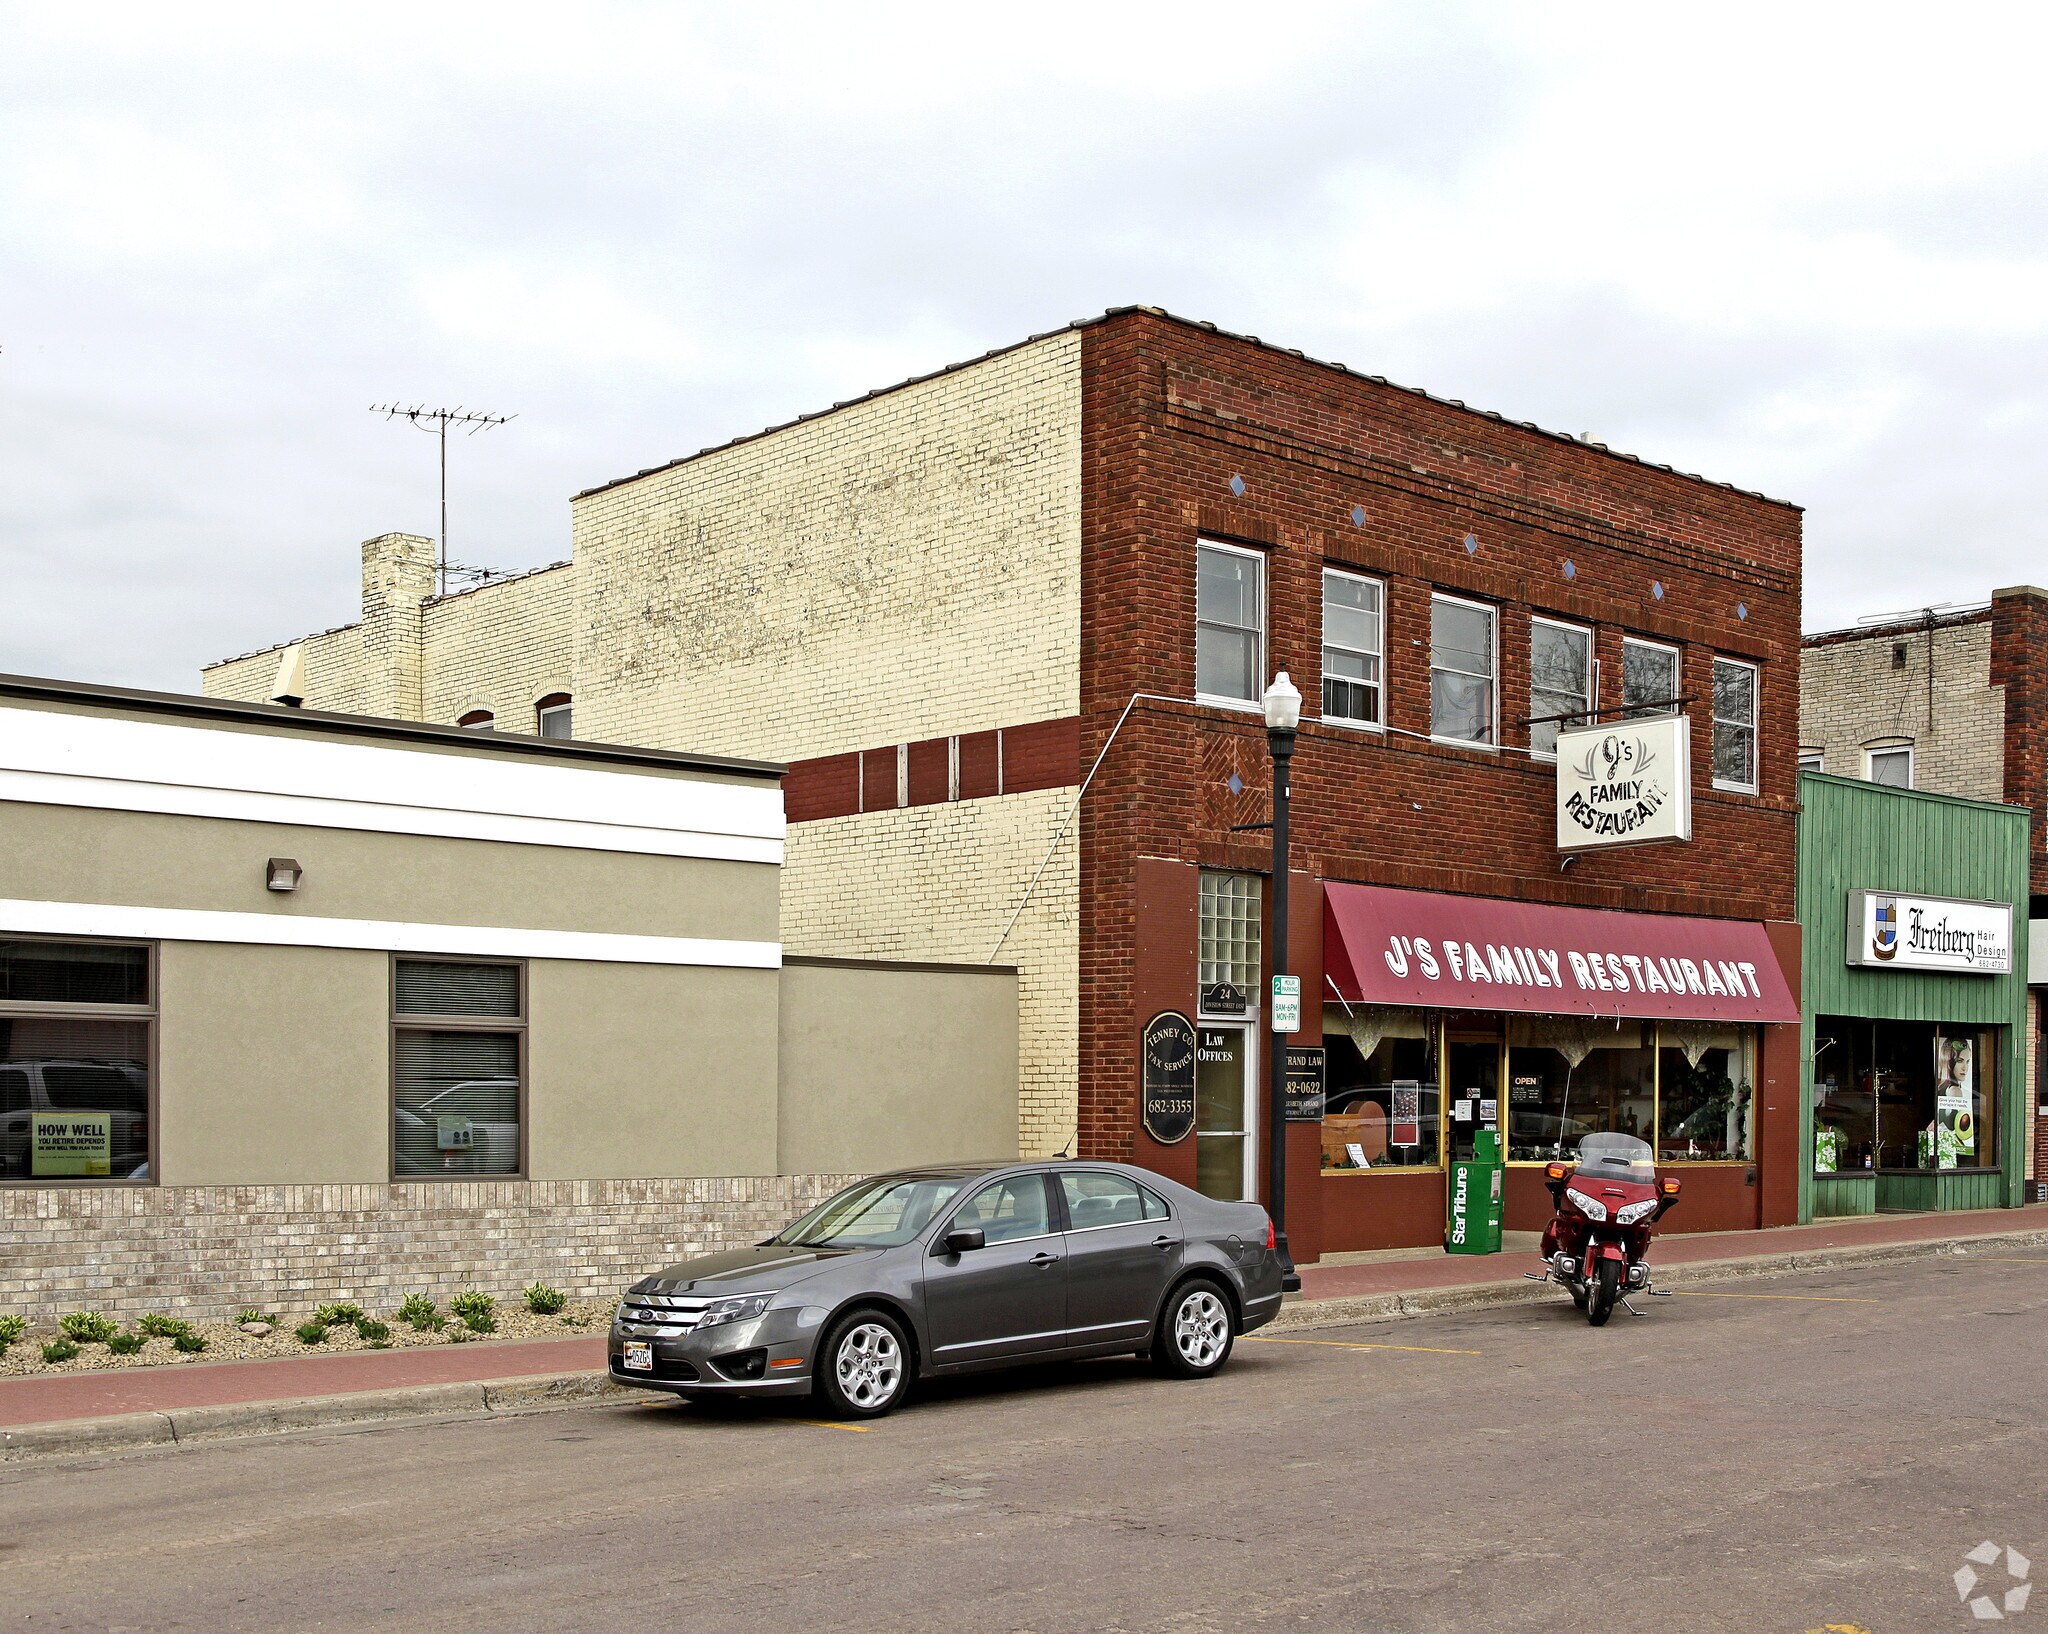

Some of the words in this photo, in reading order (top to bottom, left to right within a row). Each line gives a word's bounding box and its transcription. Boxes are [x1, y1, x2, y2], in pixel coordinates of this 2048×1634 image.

[1590, 780, 1643, 804] FAMILY
[1906, 907, 1975, 963] Freiberg
[1977, 929, 1995, 941] Hair
[1977, 944, 2007, 958] Design
[1384, 935, 1440, 980] J'S
[1442, 940, 1563, 988] FAMILY
[1567, 950, 1761, 998] RESTAURANT
[1274, 981, 1281, 993] 2
[1220, 989, 1231, 1000] 24
[1275, 1003, 1298, 1012] 8AM-6PM
[1276, 1013, 1296, 1021] MON-FRI
[1148, 1028, 1180, 1047] TENNEY
[1148, 1051, 1163, 1068] TAX
[1164, 1052, 1193, 1071] SERVICE
[1308, 1056, 1323, 1066] LAW
[1285, 1081, 1321, 1094] 82-0622
[1515, 1077, 1536, 1085] OPEN
[1148, 1099, 1192, 1114] 682-3355
[38, 1124, 67, 1136] HOW
[72, 1124, 105, 1136] WELL
[1452, 1166, 1467, 1245] StarTribune
